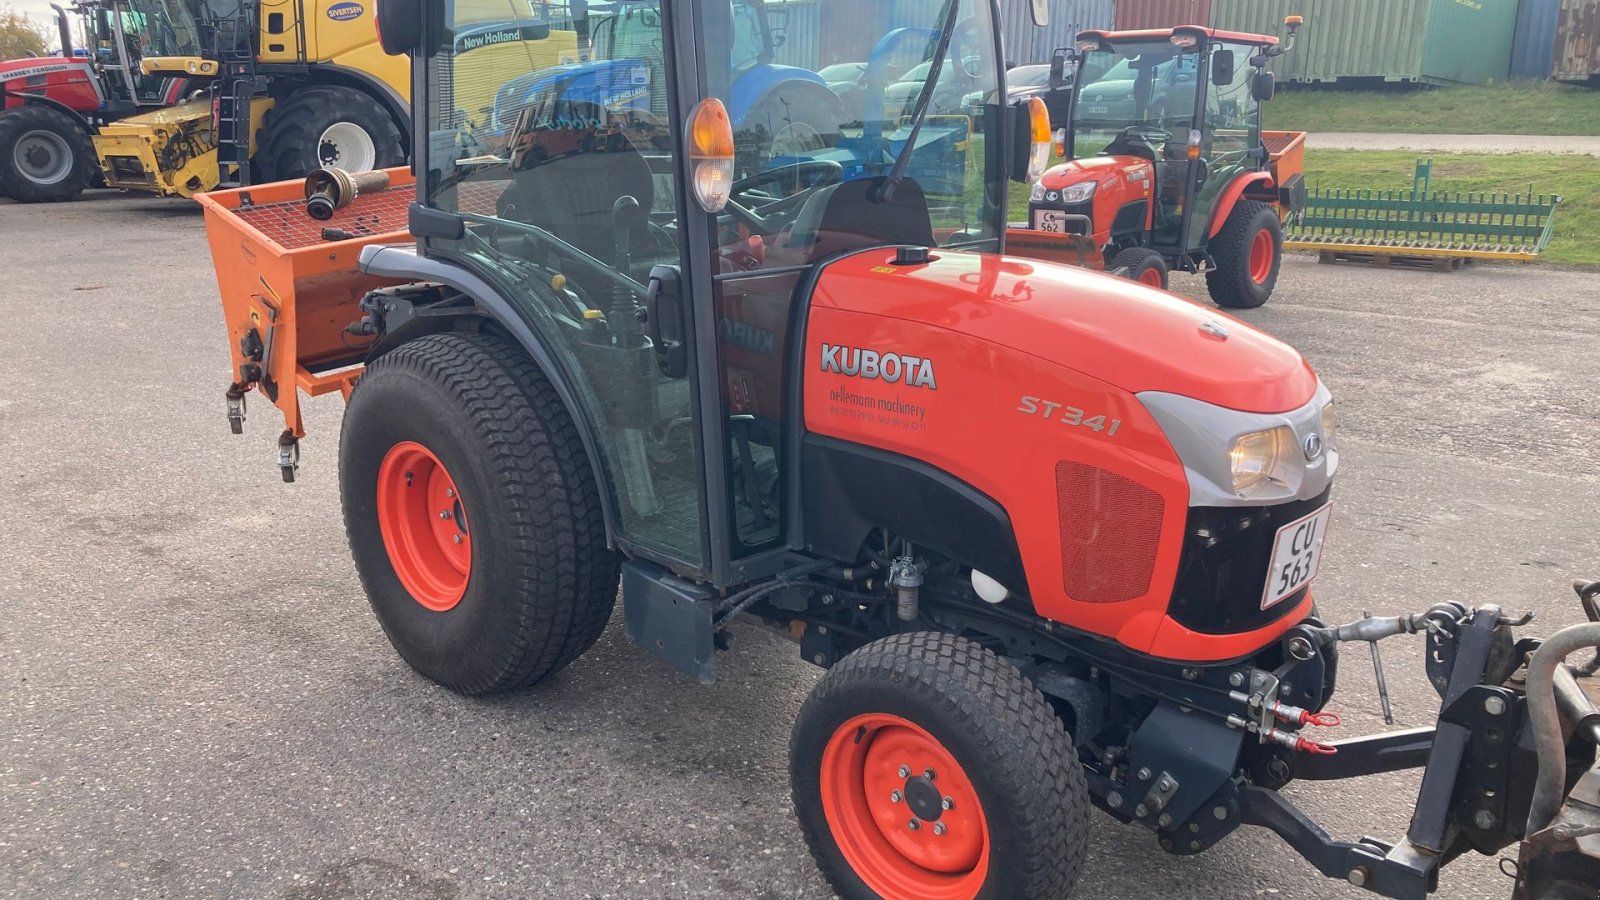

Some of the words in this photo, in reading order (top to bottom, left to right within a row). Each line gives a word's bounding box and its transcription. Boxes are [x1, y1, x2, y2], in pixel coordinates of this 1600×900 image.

[329, 6, 362, 17] SIVERTSEN
[464, 37, 483, 49] New
[485, 30, 520, 44] Holland
[2, 68, 30, 79] MASSEY
[33, 65, 67, 73] FERGUSON
[604, 94, 620, 106] NEW
[621, 86, 647, 99] HOLLAND
[1041, 222, 1058, 233] 562
[820, 342, 937, 390] KUBOTA
[830, 385, 876, 408] nellemann
[877, 395, 926, 421] machinery
[1291, 516, 1318, 556] CU
[1277, 550, 1313, 595] 563
